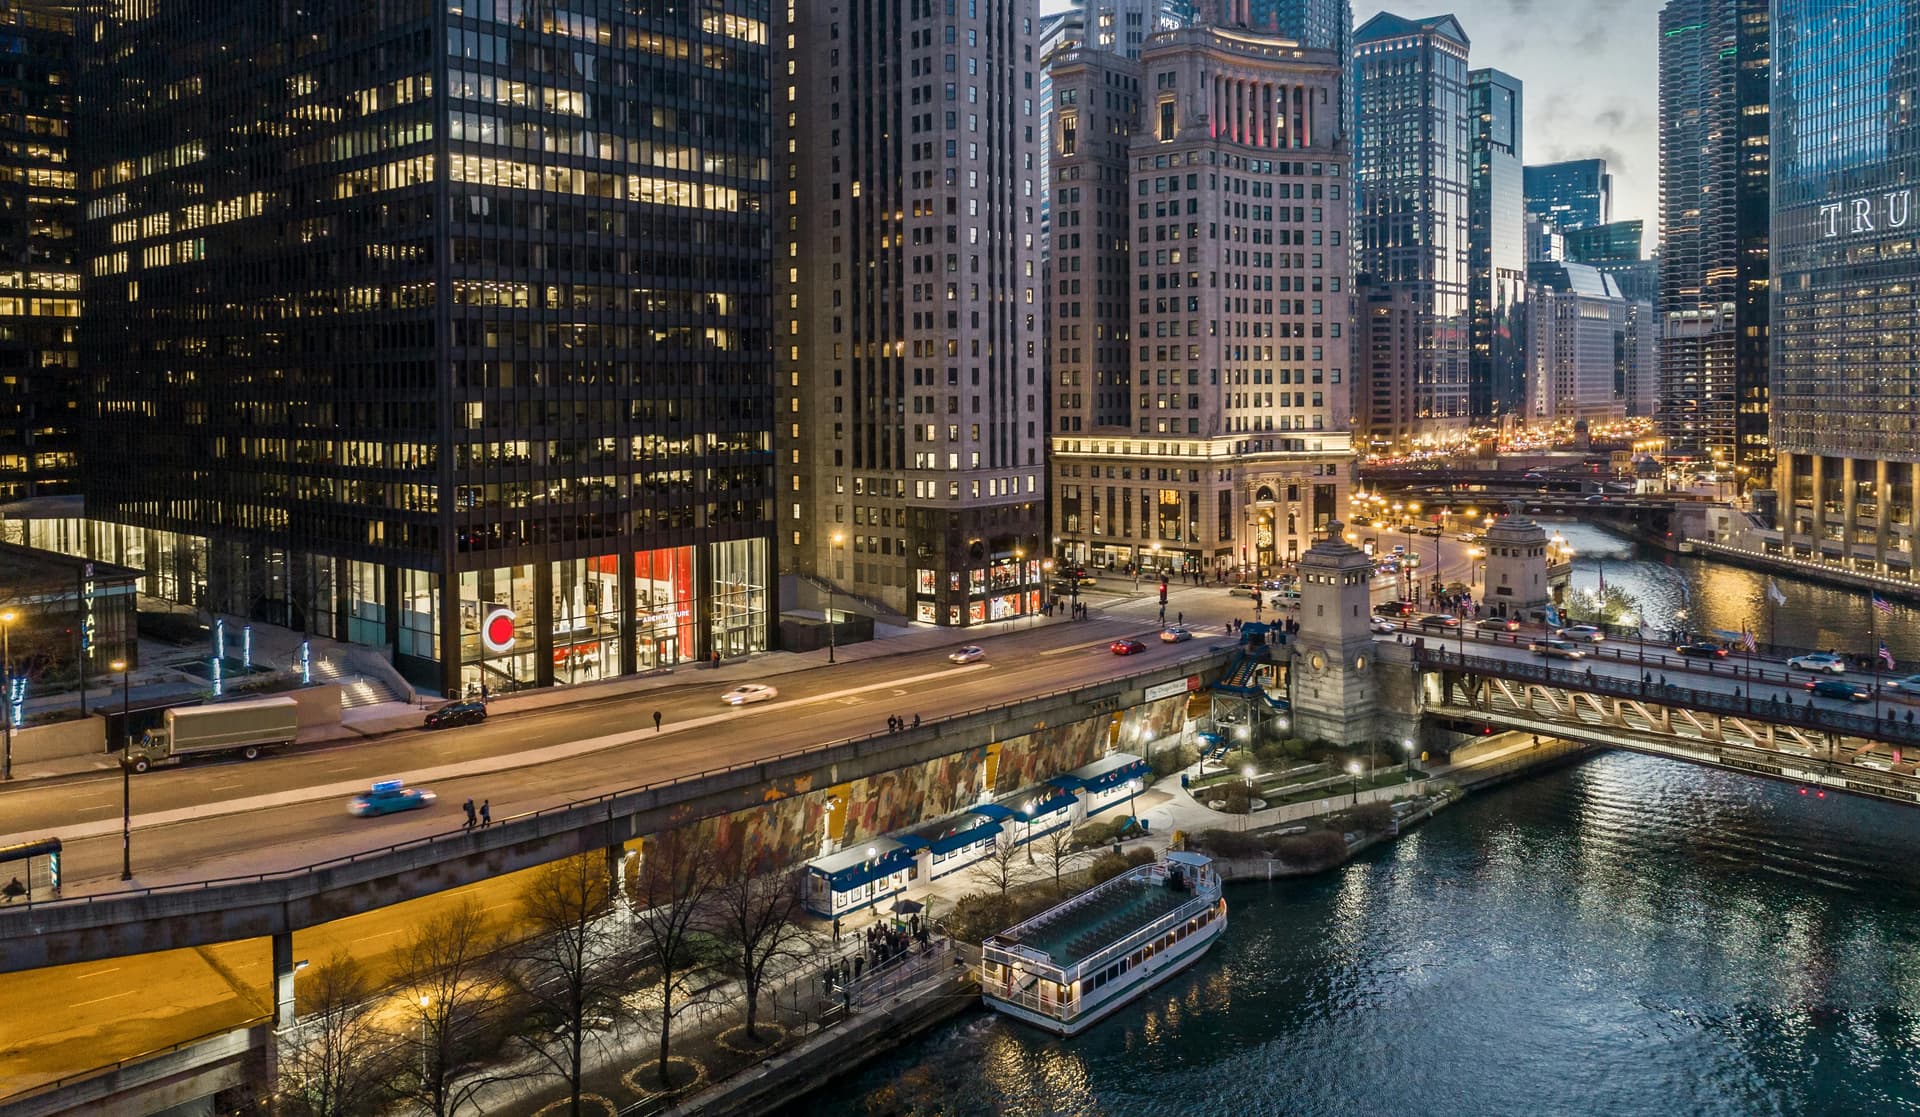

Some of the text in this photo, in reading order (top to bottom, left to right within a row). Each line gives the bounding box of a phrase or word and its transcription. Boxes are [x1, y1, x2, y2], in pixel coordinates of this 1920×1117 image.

[1820, 189, 1911, 237] TRU
[85, 581, 96, 658] HYATT
[642, 610, 690, 623] ARCHITECTURE
